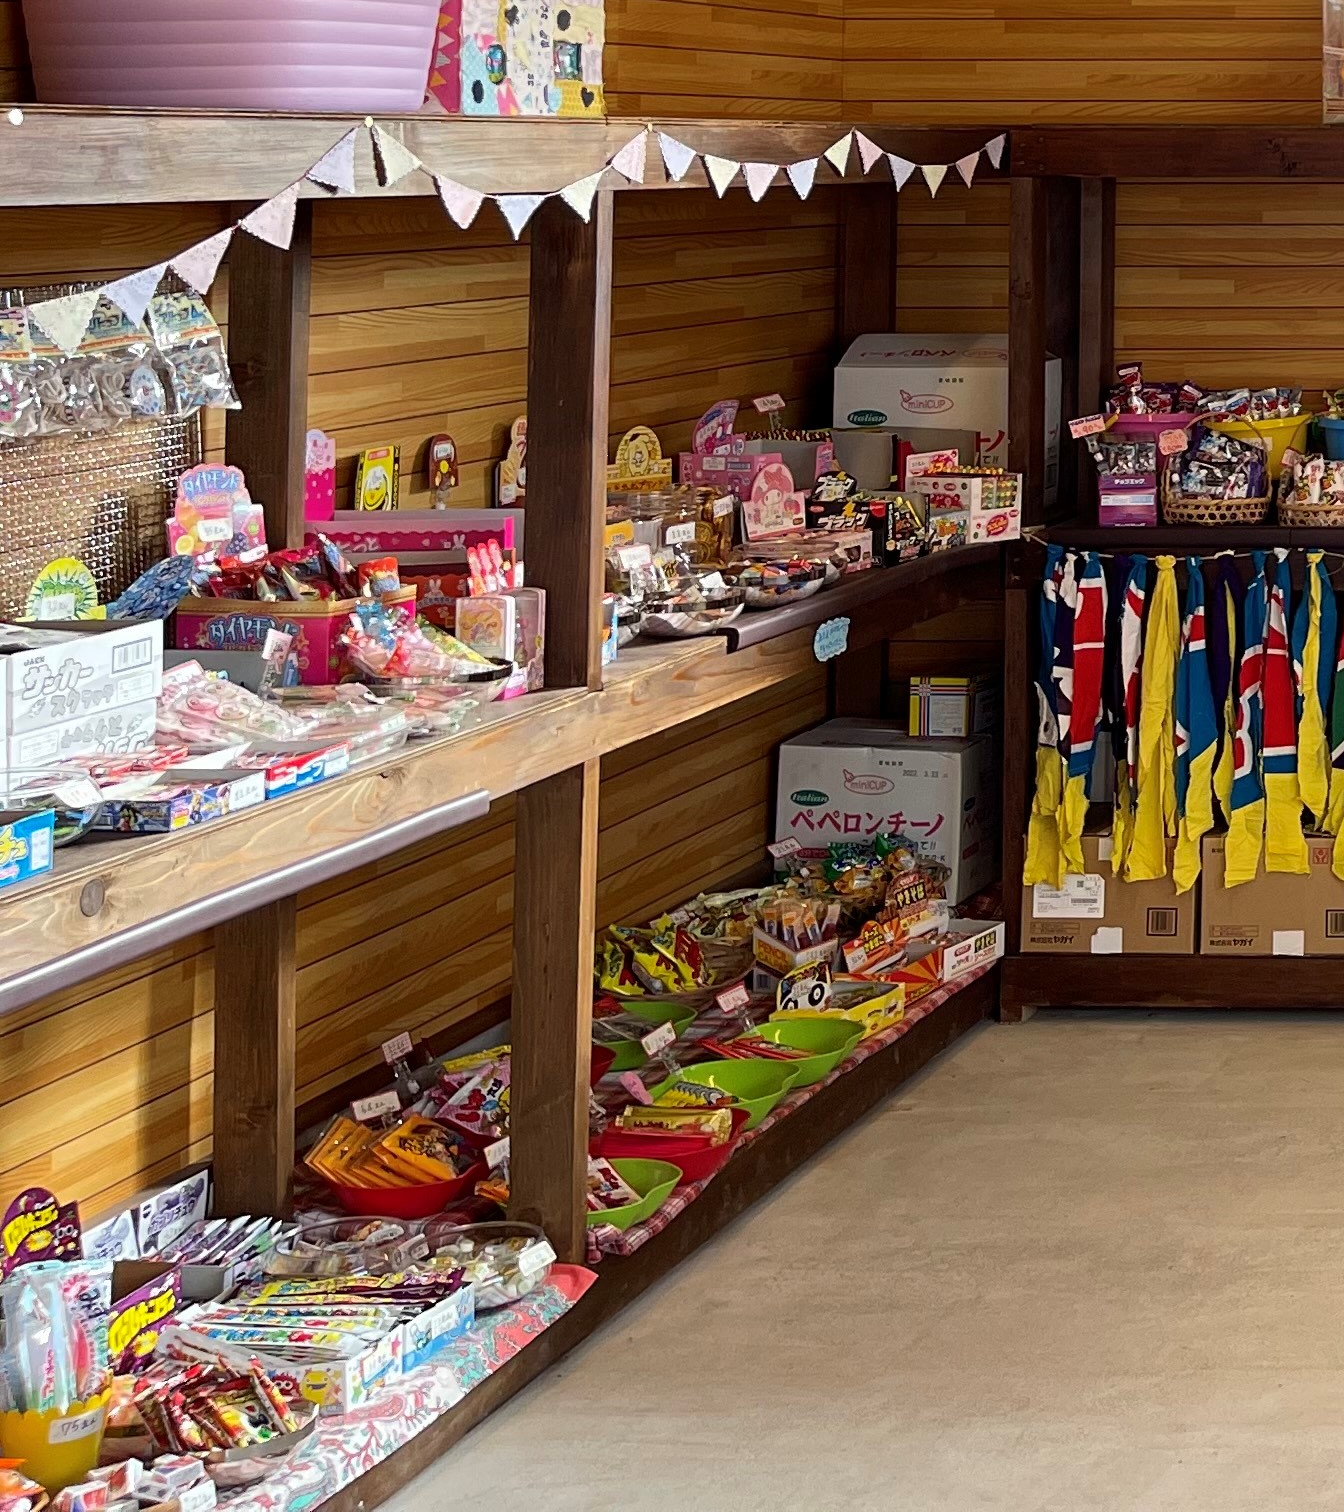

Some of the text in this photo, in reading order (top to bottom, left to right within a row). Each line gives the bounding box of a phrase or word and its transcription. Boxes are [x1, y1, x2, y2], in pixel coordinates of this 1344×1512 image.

[908, 399, 945, 410] miniCUP
[849, 411, 887, 424] Italian
[183, 469, 240, 494] ダイヤモンド
[22, 658, 94, 700] サッカー
[50, 684, 114, 718] スクラッチ
[850, 780, 887, 791] miniCUP
[792, 793, 828, 803] Italian
[790, 809, 945, 837] ペペロンチーノ
[1030, 934, 1076, 945] 株式会社ヤガイ
[1208, 938, 1255, 947] 株式会社ヤガイ
